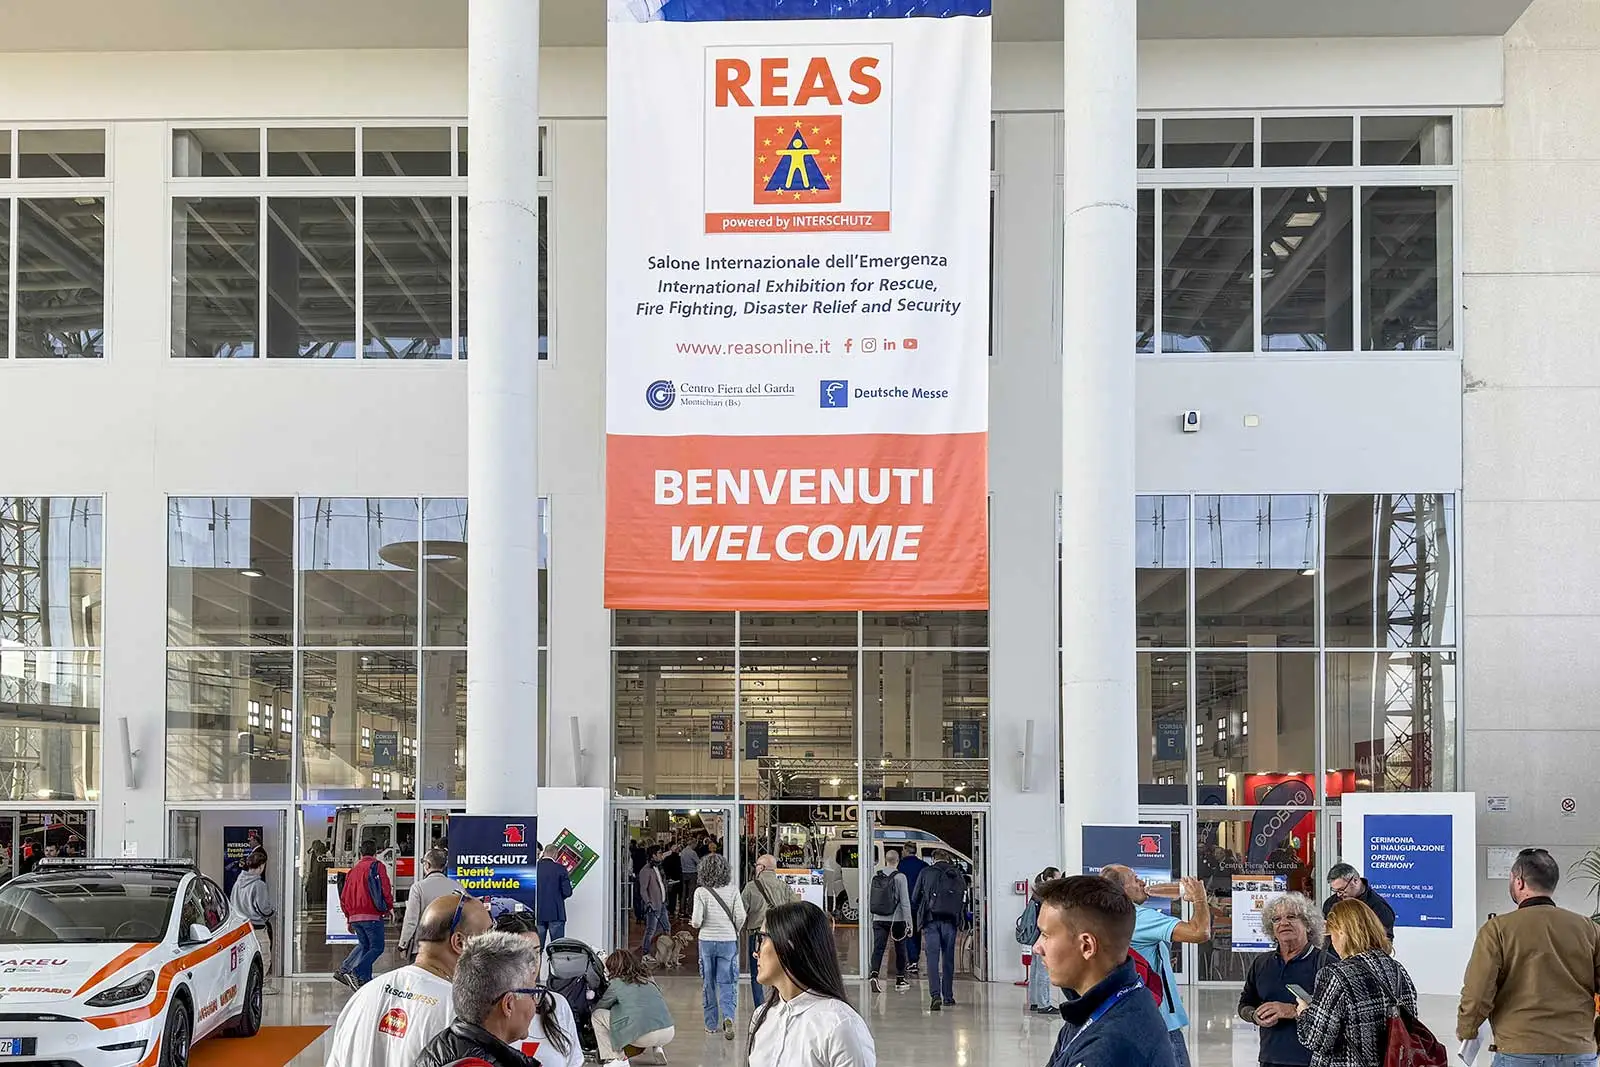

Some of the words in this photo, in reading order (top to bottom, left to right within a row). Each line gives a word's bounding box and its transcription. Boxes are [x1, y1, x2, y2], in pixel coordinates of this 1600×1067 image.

[715, 57, 882, 107] REAS
[722, 217, 773, 230] powered
[776, 216, 791, 230] by
[792, 215, 873, 227] INTERSCHUTZ
[647, 255, 700, 271] Salone
[705, 254, 820, 271] Internazionale
[657, 279, 761, 295] International
[765, 278, 846, 294] Exhibition
[850, 278, 874, 293] for
[879, 277, 938, 293] Rescue,
[636, 301, 664, 316] Fire
[669, 300, 738, 318] Fighting,
[743, 300, 808, 316] Disaster
[812, 299, 857, 315] Relief
[861, 298, 892, 314] and
[897, 298, 961, 316] Security
[676, 339, 831, 356] www.reasonline.it
[680, 383, 714, 394] Centro
[717, 383, 743, 394] Fiera
[745, 383, 761, 394] del
[763, 383, 795, 394] Garda
[854, 386, 909, 399] Deutsche
[911, 387, 949, 399] Messe
[680, 398, 723, 408] Montichiari
[724, 398, 741, 408] (Bs)
[654, 468, 935, 506] BENVENUTI
[671, 524, 925, 562] WELCOME
[752, 739, 760, 749] C
[963, 739, 971, 749] D
[1167, 737, 1175, 747] E
[382, 747, 390, 756] A
[1370, 836, 1415, 844] CERIMONIA
[1380, 844, 1446, 852] INAUGURAZIONE
[456, 854, 528, 865] INTERSCHUTZ
[1219, 861, 1243, 870] Centro
[1263, 860, 1275, 869] del
[1276, 861, 1298, 869] Garda
[456, 866, 495, 877] Events
[457, 878, 521, 889] Worldwide
[8, 986, 72, 995] SANITARIO
